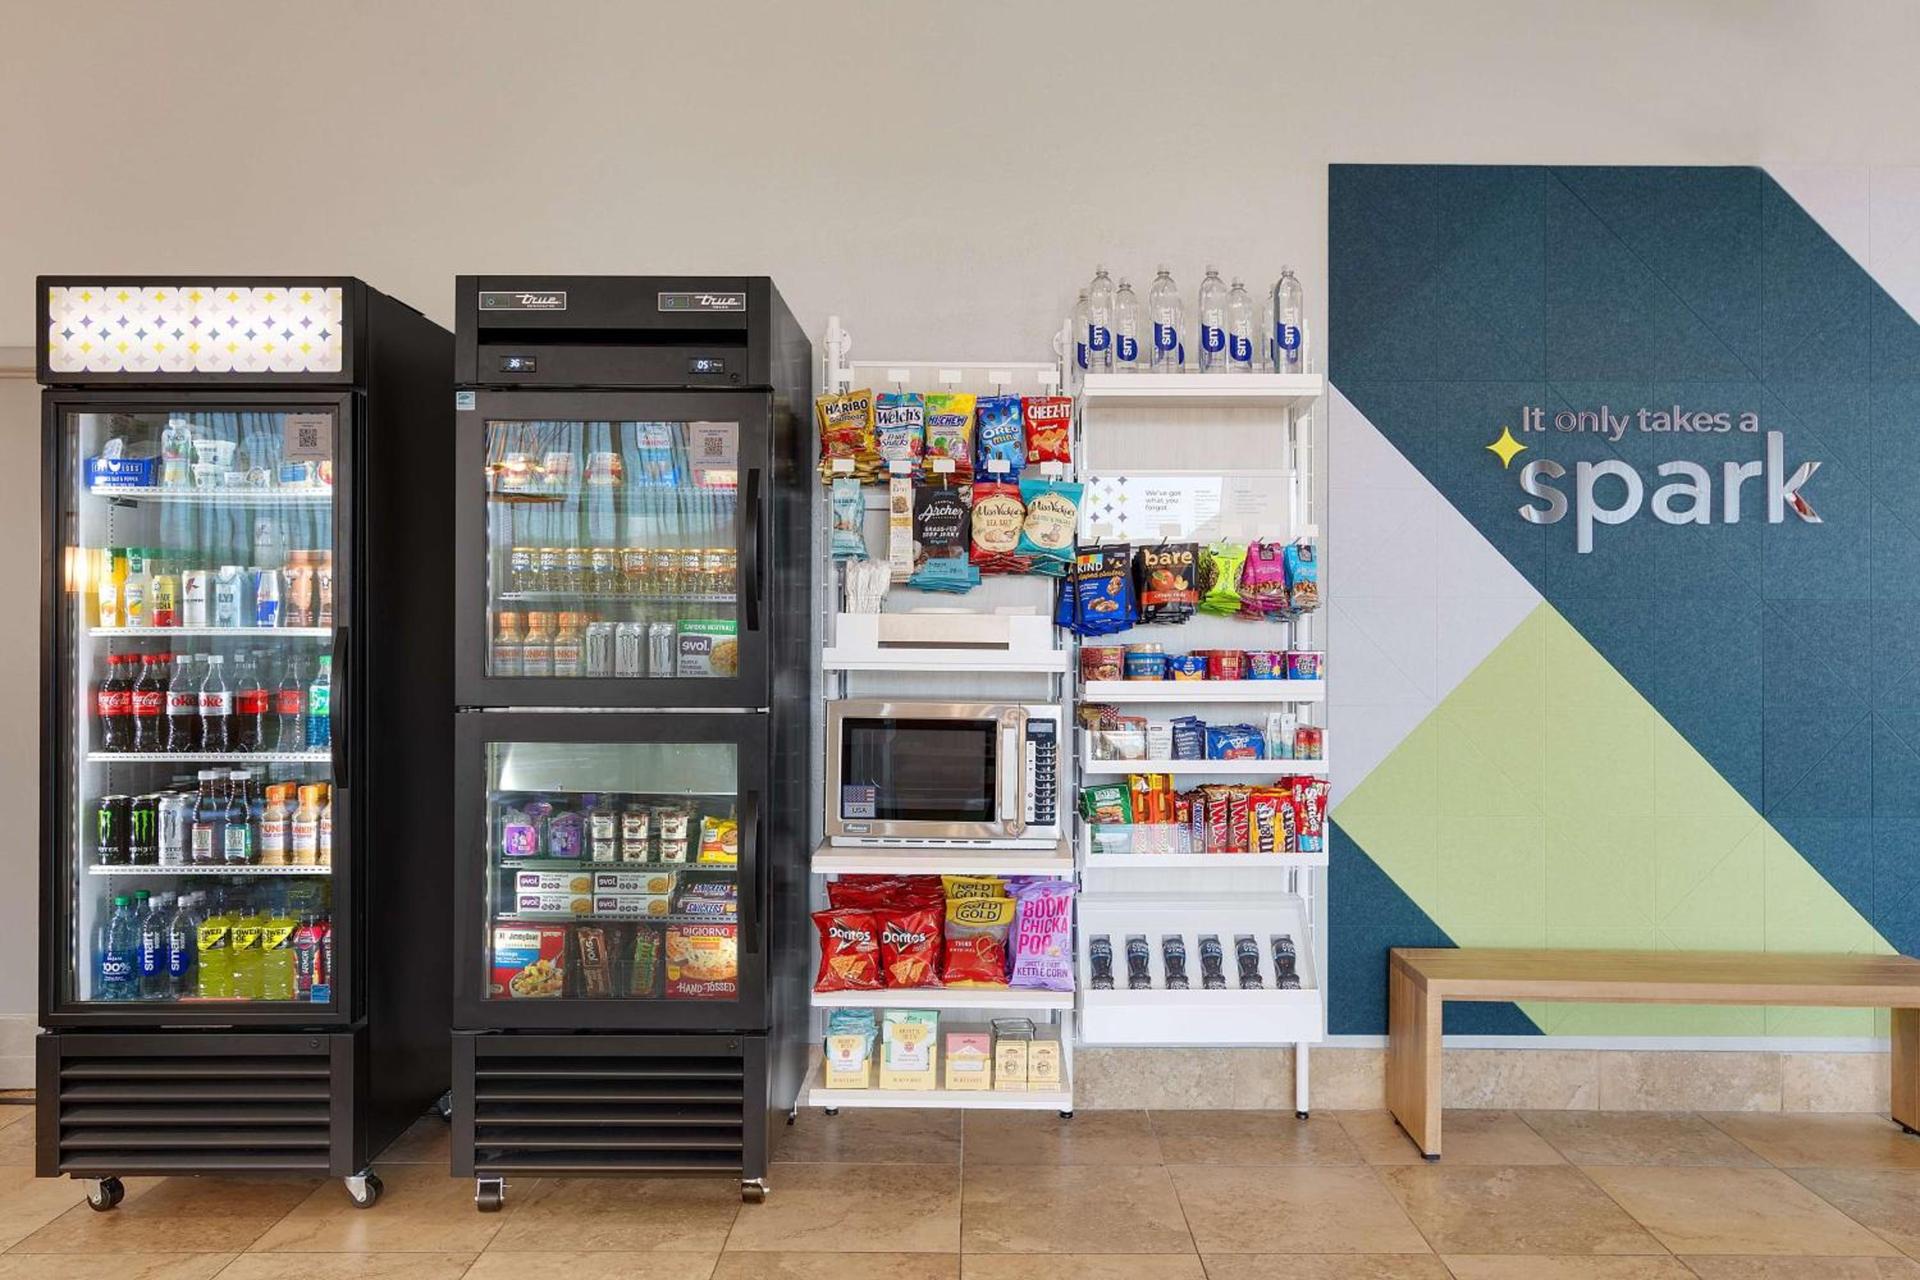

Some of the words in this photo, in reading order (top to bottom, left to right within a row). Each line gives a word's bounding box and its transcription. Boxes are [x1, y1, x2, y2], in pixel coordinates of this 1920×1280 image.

[825, 399, 868, 415] HARIBO
[1028, 405, 1070, 419] CHEEZ-IT
[877, 409, 921, 424] Welch's
[928, 416, 966, 426] HI-CHEW
[1522, 406, 1545, 432] It
[1555, 405, 1630, 442] only
[1637, 405, 1731, 433] takes
[1739, 412, 1759, 433] a
[983, 426, 1018, 439] OREO
[1518, 431, 1824, 554] spark
[918, 504, 963, 522] Archer
[1144, 549, 1192, 565] bare
[1078, 562, 1103, 574] KIND
[171, 697, 196, 708] oke
[1209, 797, 1228, 846] TWIX
[1231, 796, 1248, 846] TWIX
[961, 910, 997, 919] GOLD
[1023, 896, 1069, 918] BOOM
[683, 927, 729, 936] DIGIORNO
[1021, 917, 1068, 934] CHICKA
[829, 927, 871, 941] Doritos
[883, 932, 926, 945] Doritos
[143, 931, 154, 971] smart
[171, 931, 180, 971] smart
[1018, 933, 1052, 955] POP
[103, 962, 131, 972] 100%
[1017, 967, 1046, 976] KETTLE
[1047, 968, 1068, 977] CORN
